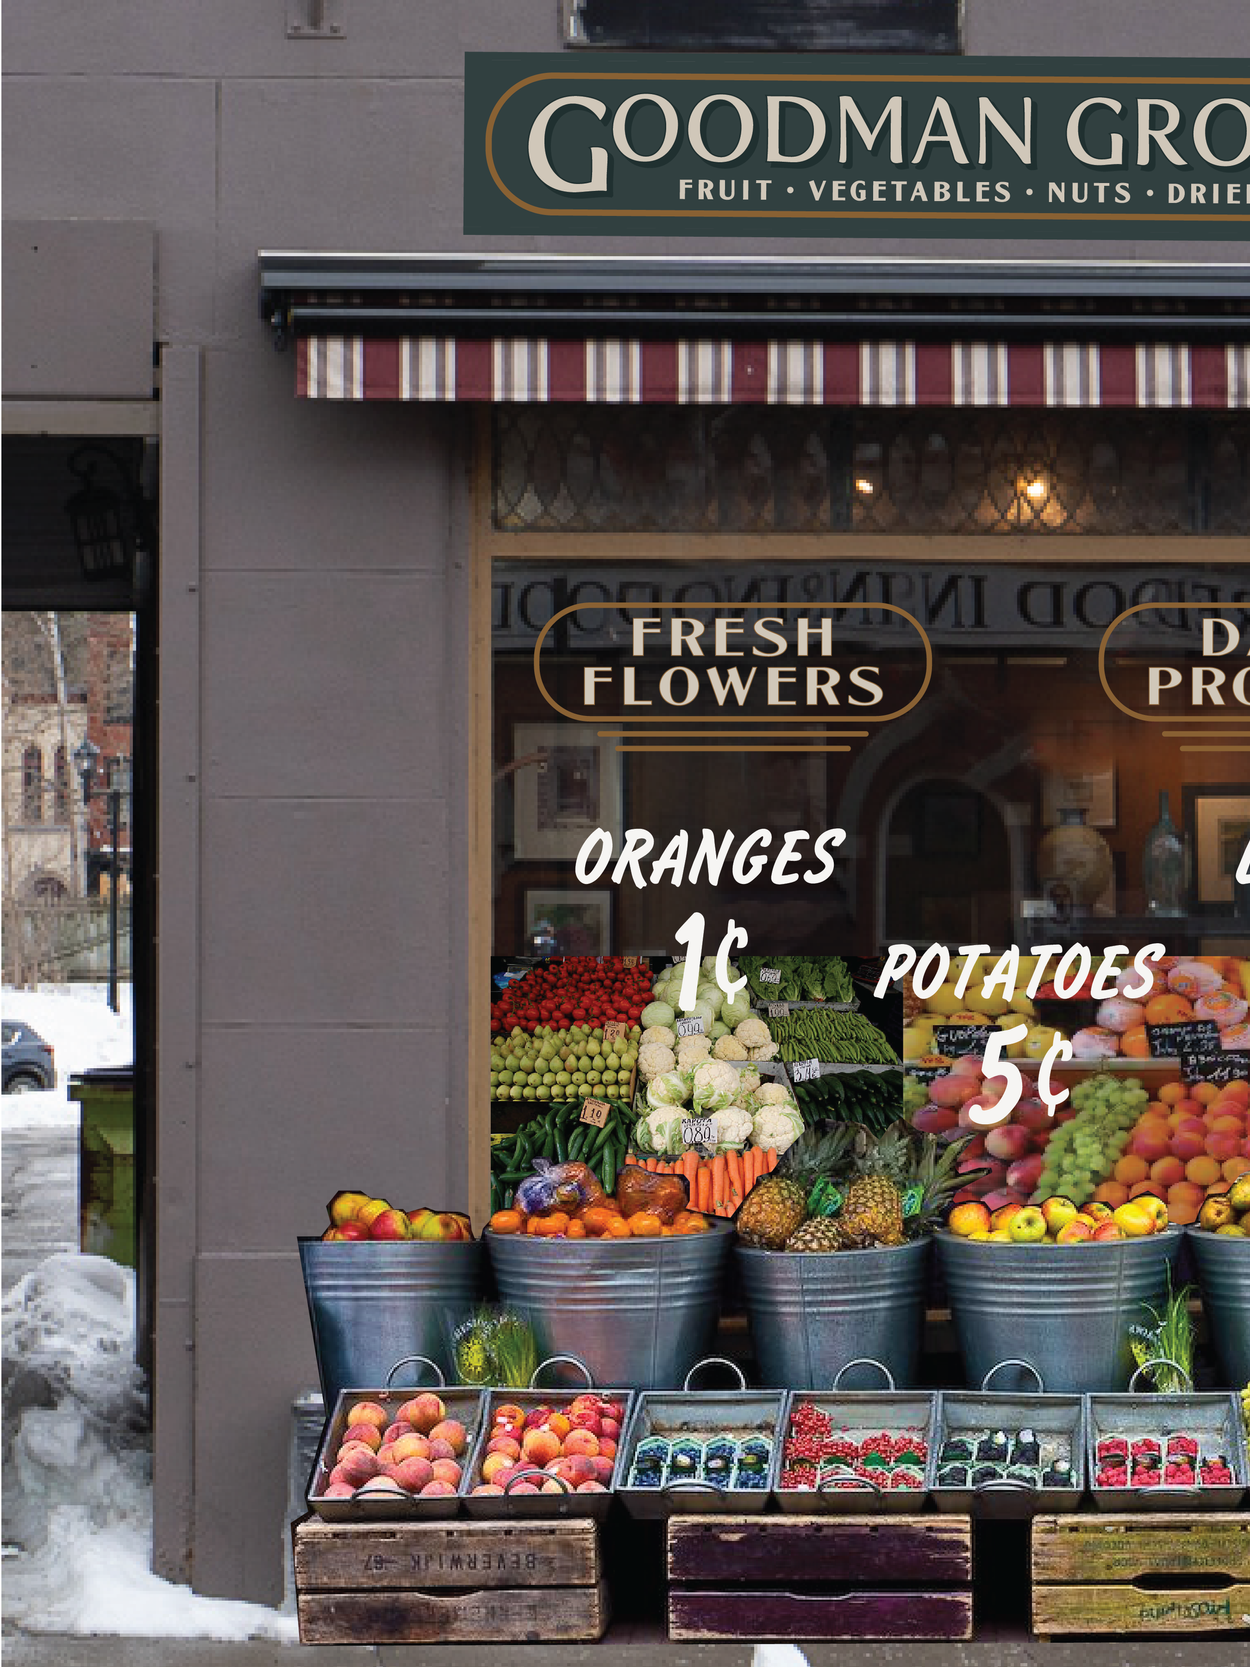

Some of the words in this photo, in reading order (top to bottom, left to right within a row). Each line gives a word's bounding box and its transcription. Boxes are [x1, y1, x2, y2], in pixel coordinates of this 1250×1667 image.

[528, 93, 1033, 193] GOODMAN
[679, 179, 772, 200] FRUIT
[808, 180, 1011, 203] VEGETABLES
[1048, 182, 1131, 204] NUTS
[632, 617, 833, 657] FRESH
[583, 666, 884, 706] FLOWERS
[575, 827, 847, 890] ORANGES
[674, 911, 749, 1012] 1¢
[873, 942, 1166, 1002] POTATOES
[968, 1023, 1073, 1125] 5¢
